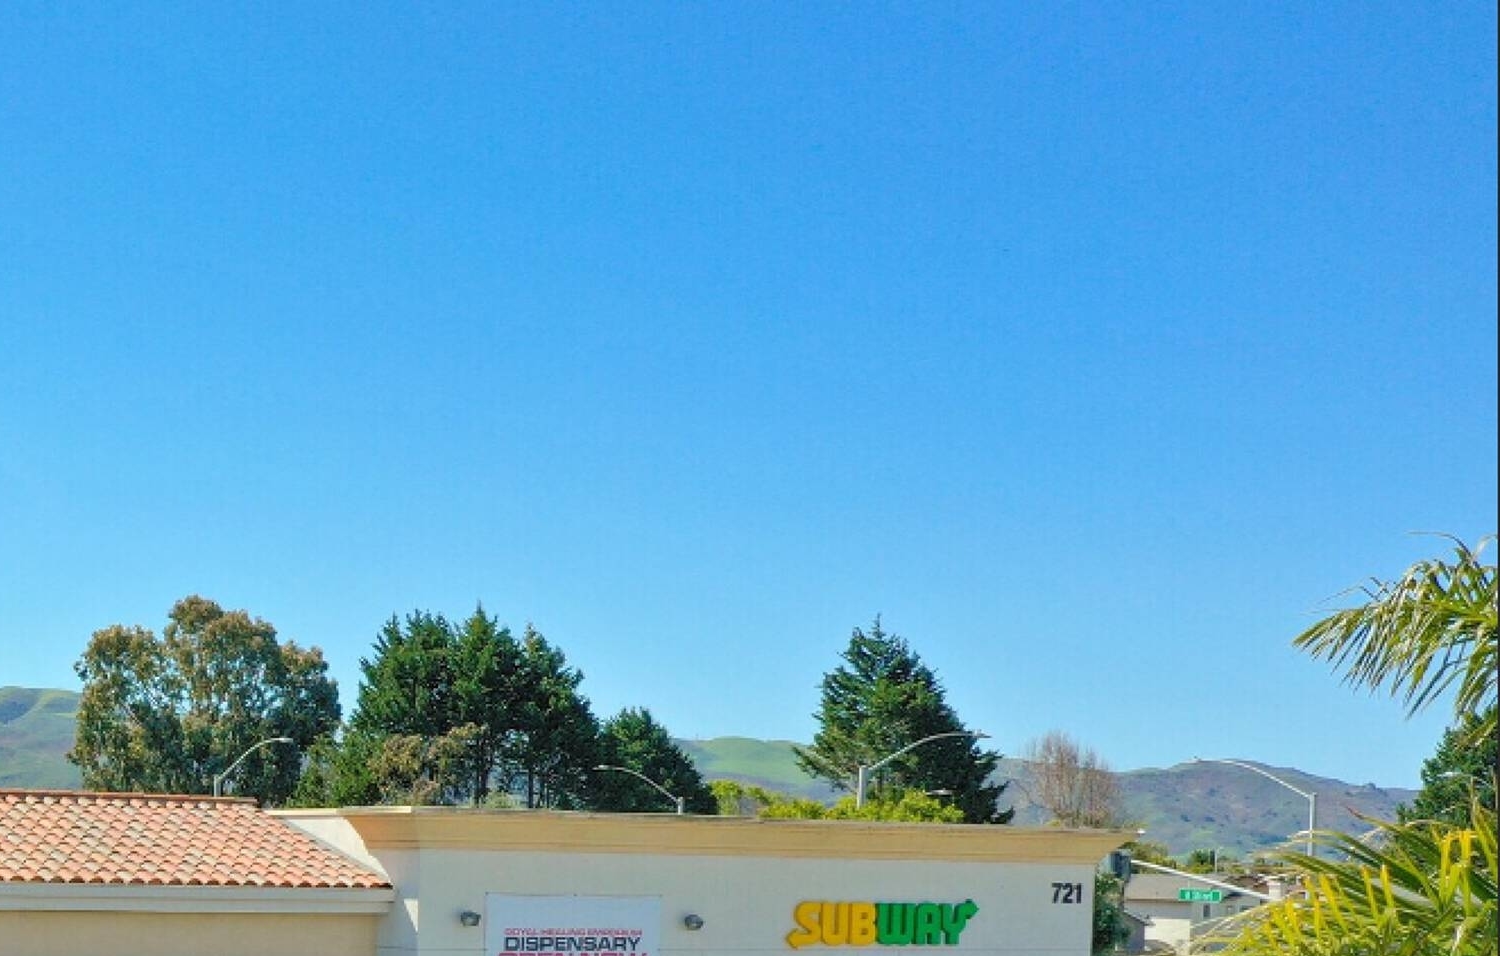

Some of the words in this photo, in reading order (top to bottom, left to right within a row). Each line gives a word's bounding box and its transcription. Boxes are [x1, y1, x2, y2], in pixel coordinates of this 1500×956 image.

[1051, 882, 1083, 904] 721
[786, 899, 979, 949] SUBWAY
[504, 936, 640, 951] DISPENSARY
